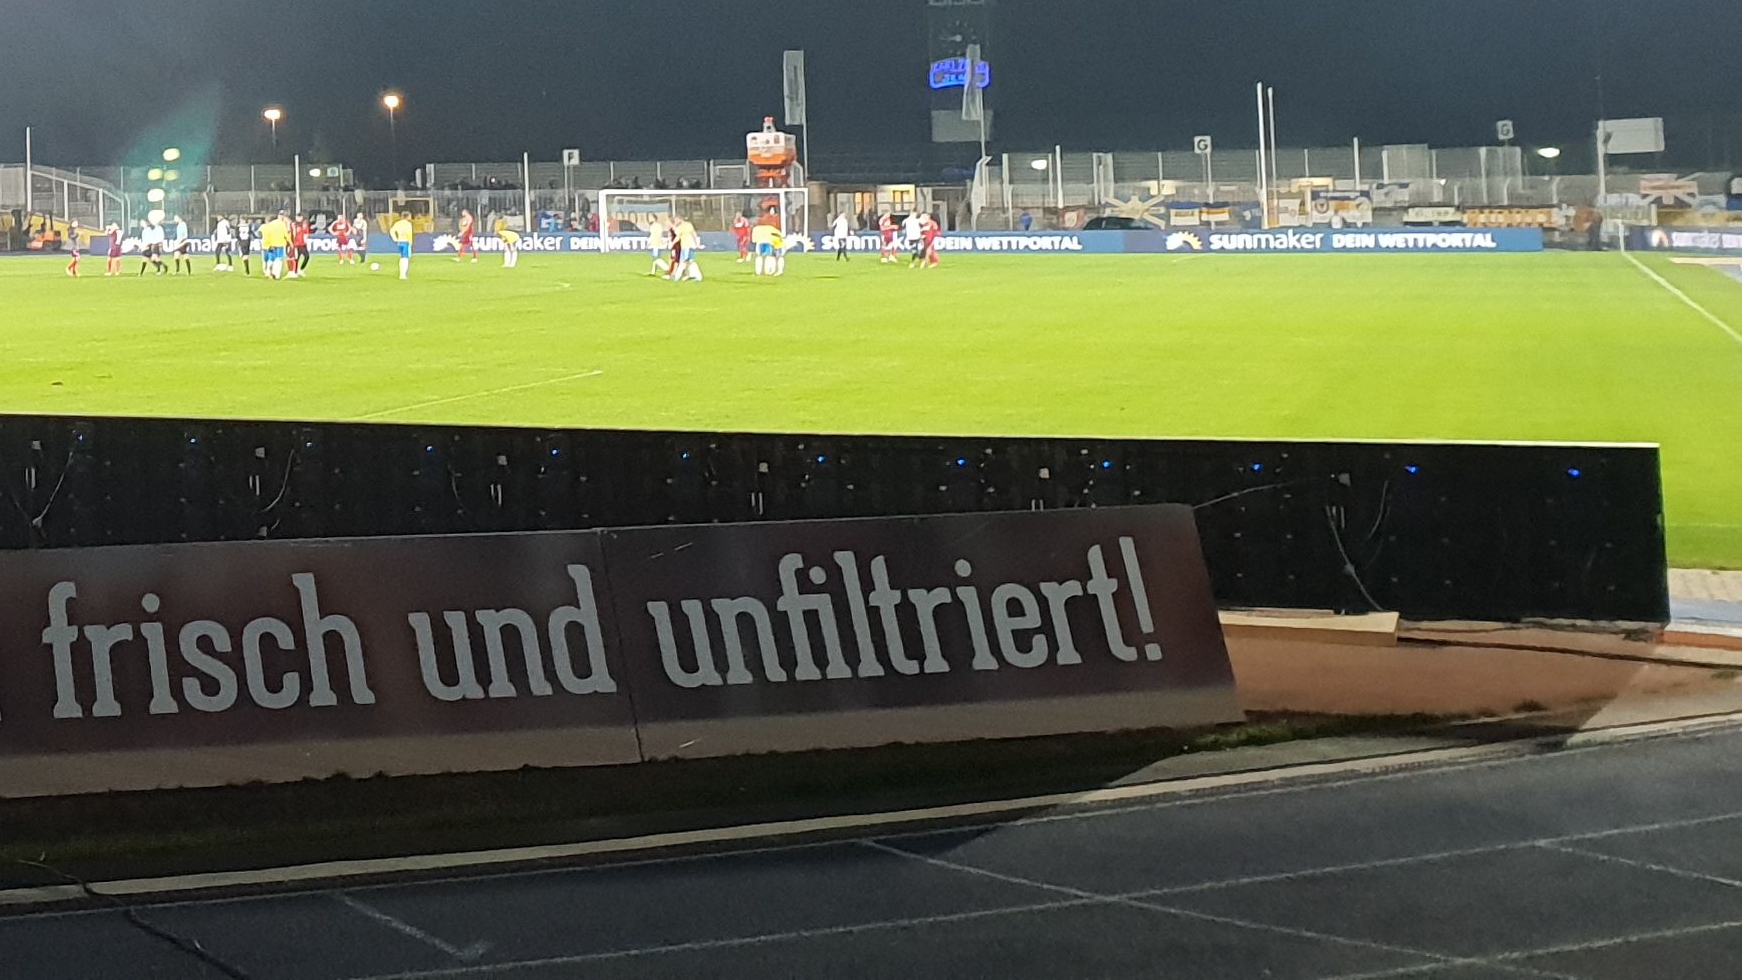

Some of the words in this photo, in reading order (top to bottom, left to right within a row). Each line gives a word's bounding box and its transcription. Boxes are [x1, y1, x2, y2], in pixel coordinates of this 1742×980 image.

[933, 235, 973, 251] DEIN
[974, 235, 1083, 251] WETTPORTAL
[1208, 228, 1324, 250] sunmaker
[1331, 231, 1376, 249] DEIN
[1377, 231, 1497, 249] WETTPORTAL
[43, 572, 376, 720] frisch
[408, 563, 618, 702] und
[646, 536, 1164, 689] unfiltriert!
